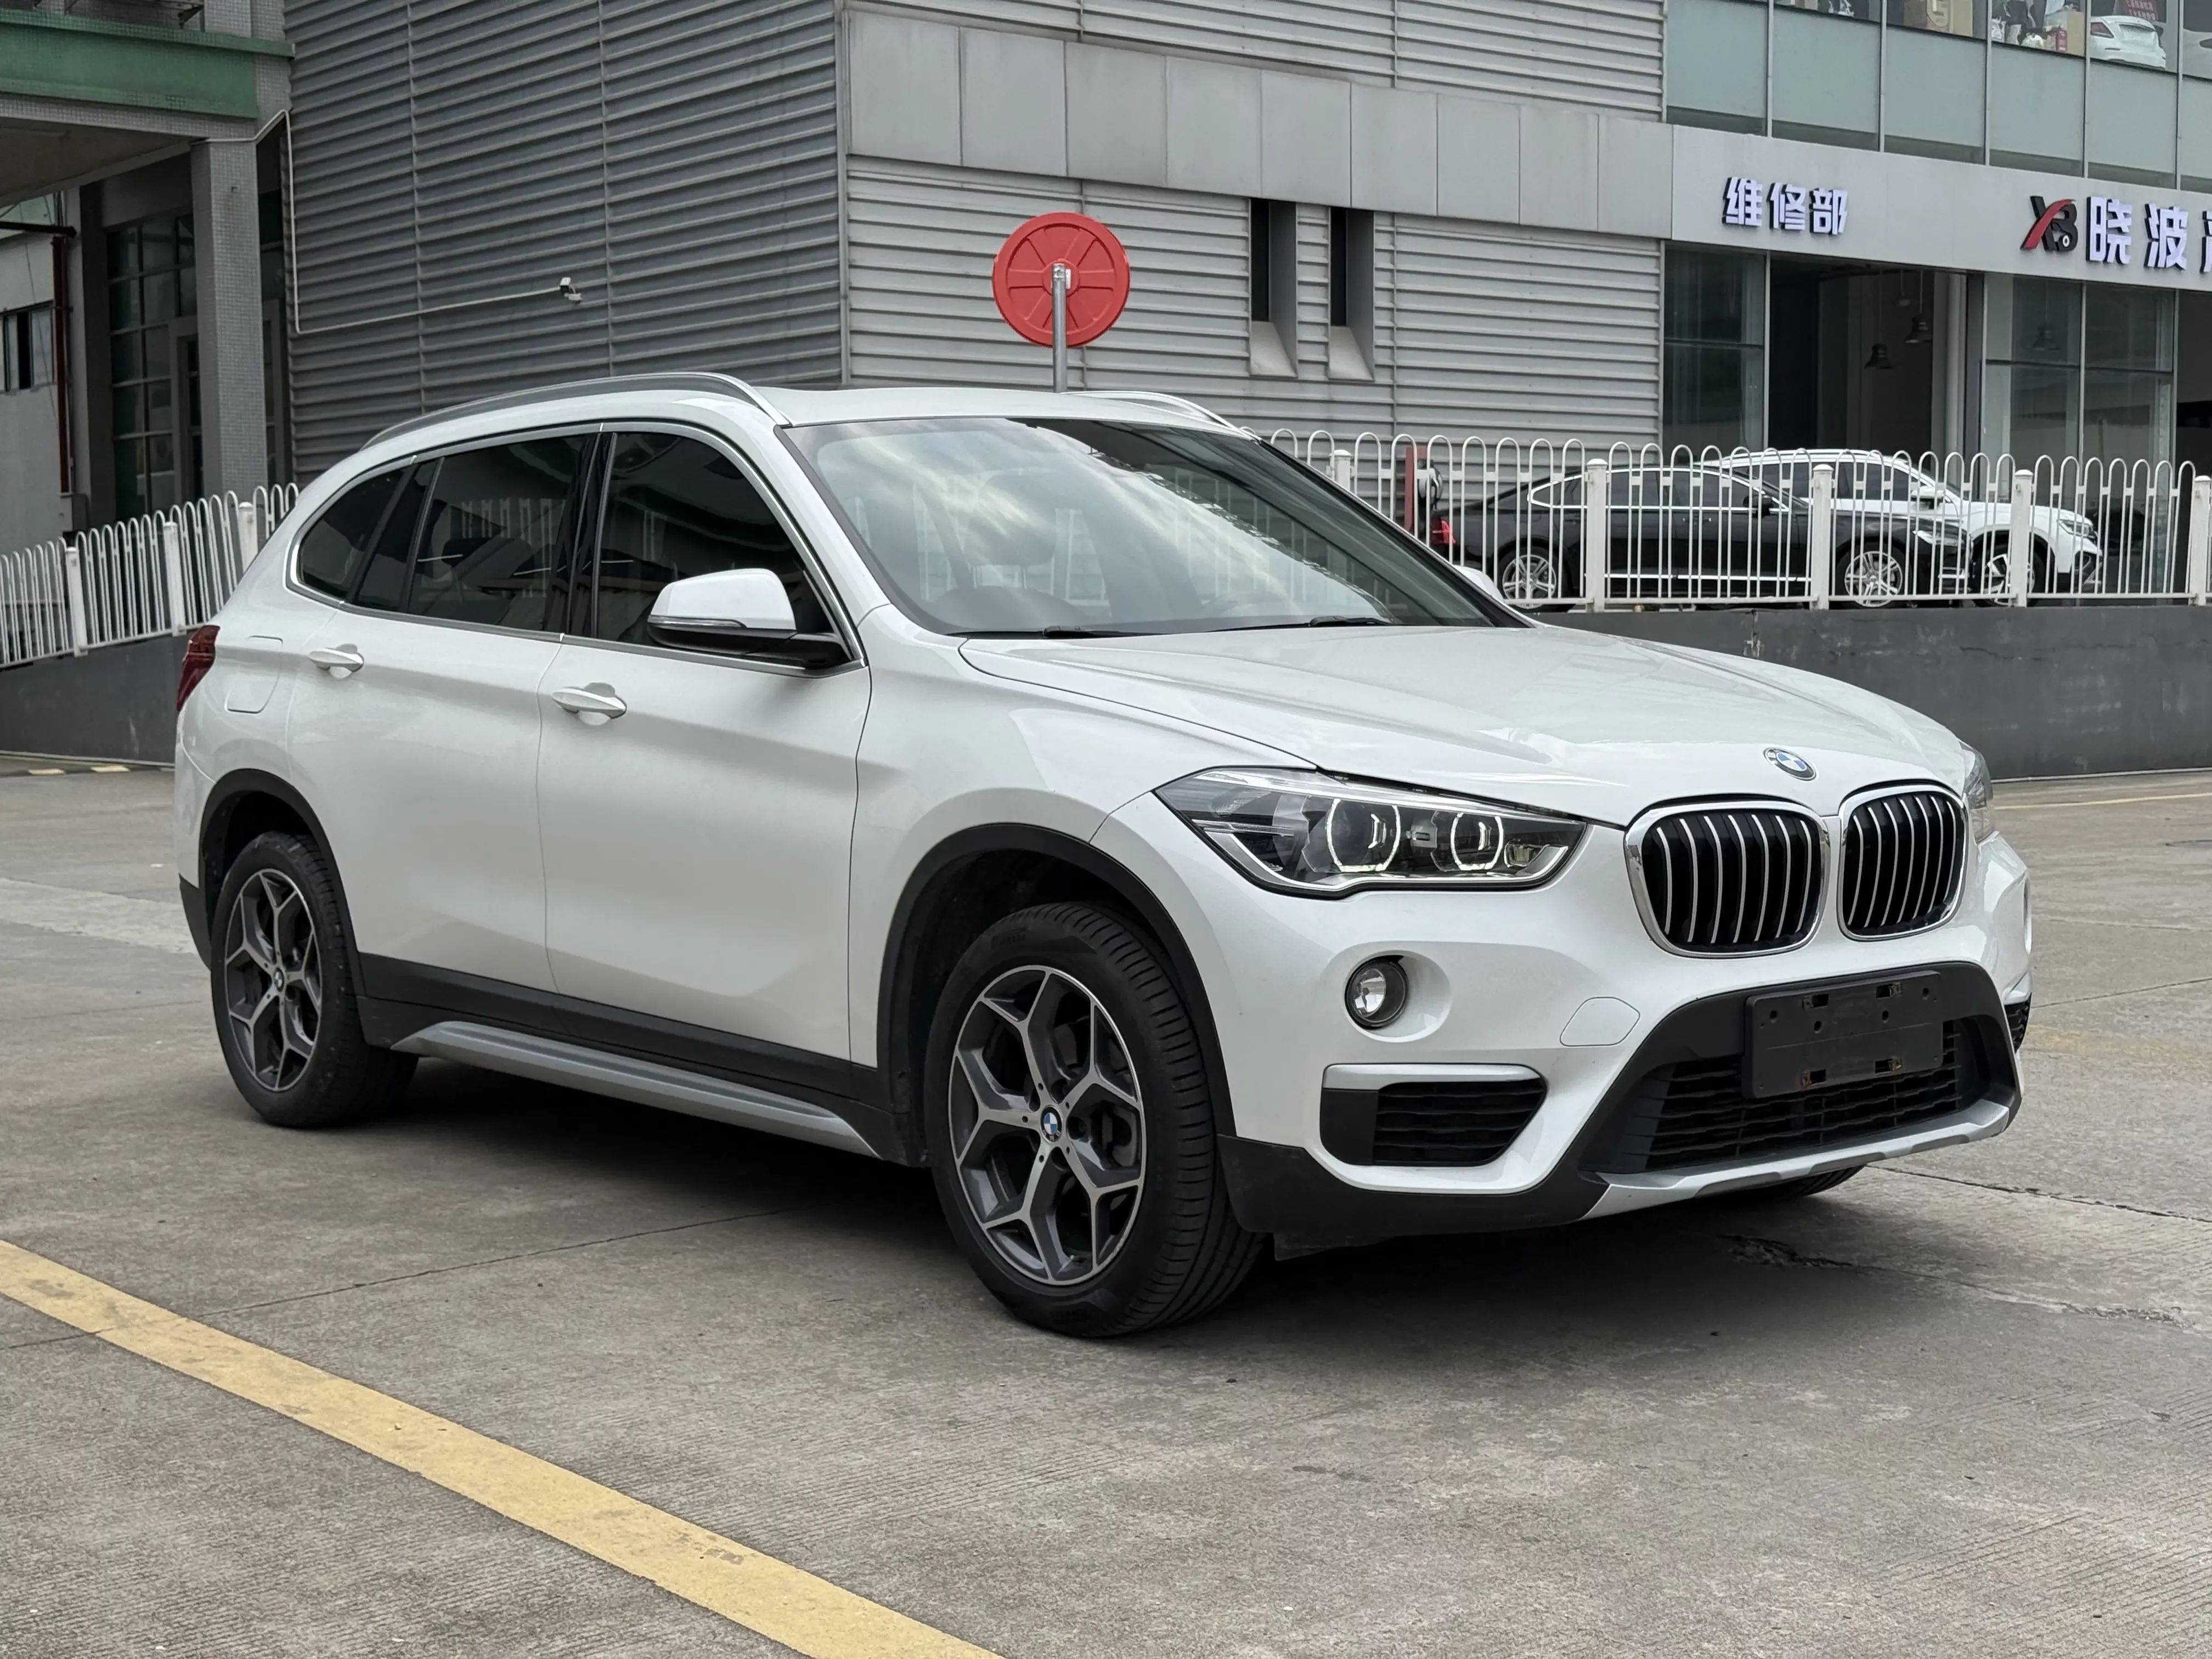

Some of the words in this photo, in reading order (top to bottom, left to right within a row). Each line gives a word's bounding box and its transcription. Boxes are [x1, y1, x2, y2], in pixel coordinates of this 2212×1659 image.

[1723, 177, 1848, 235] 维修部
[2086, 195, 2212, 273] 晓波
